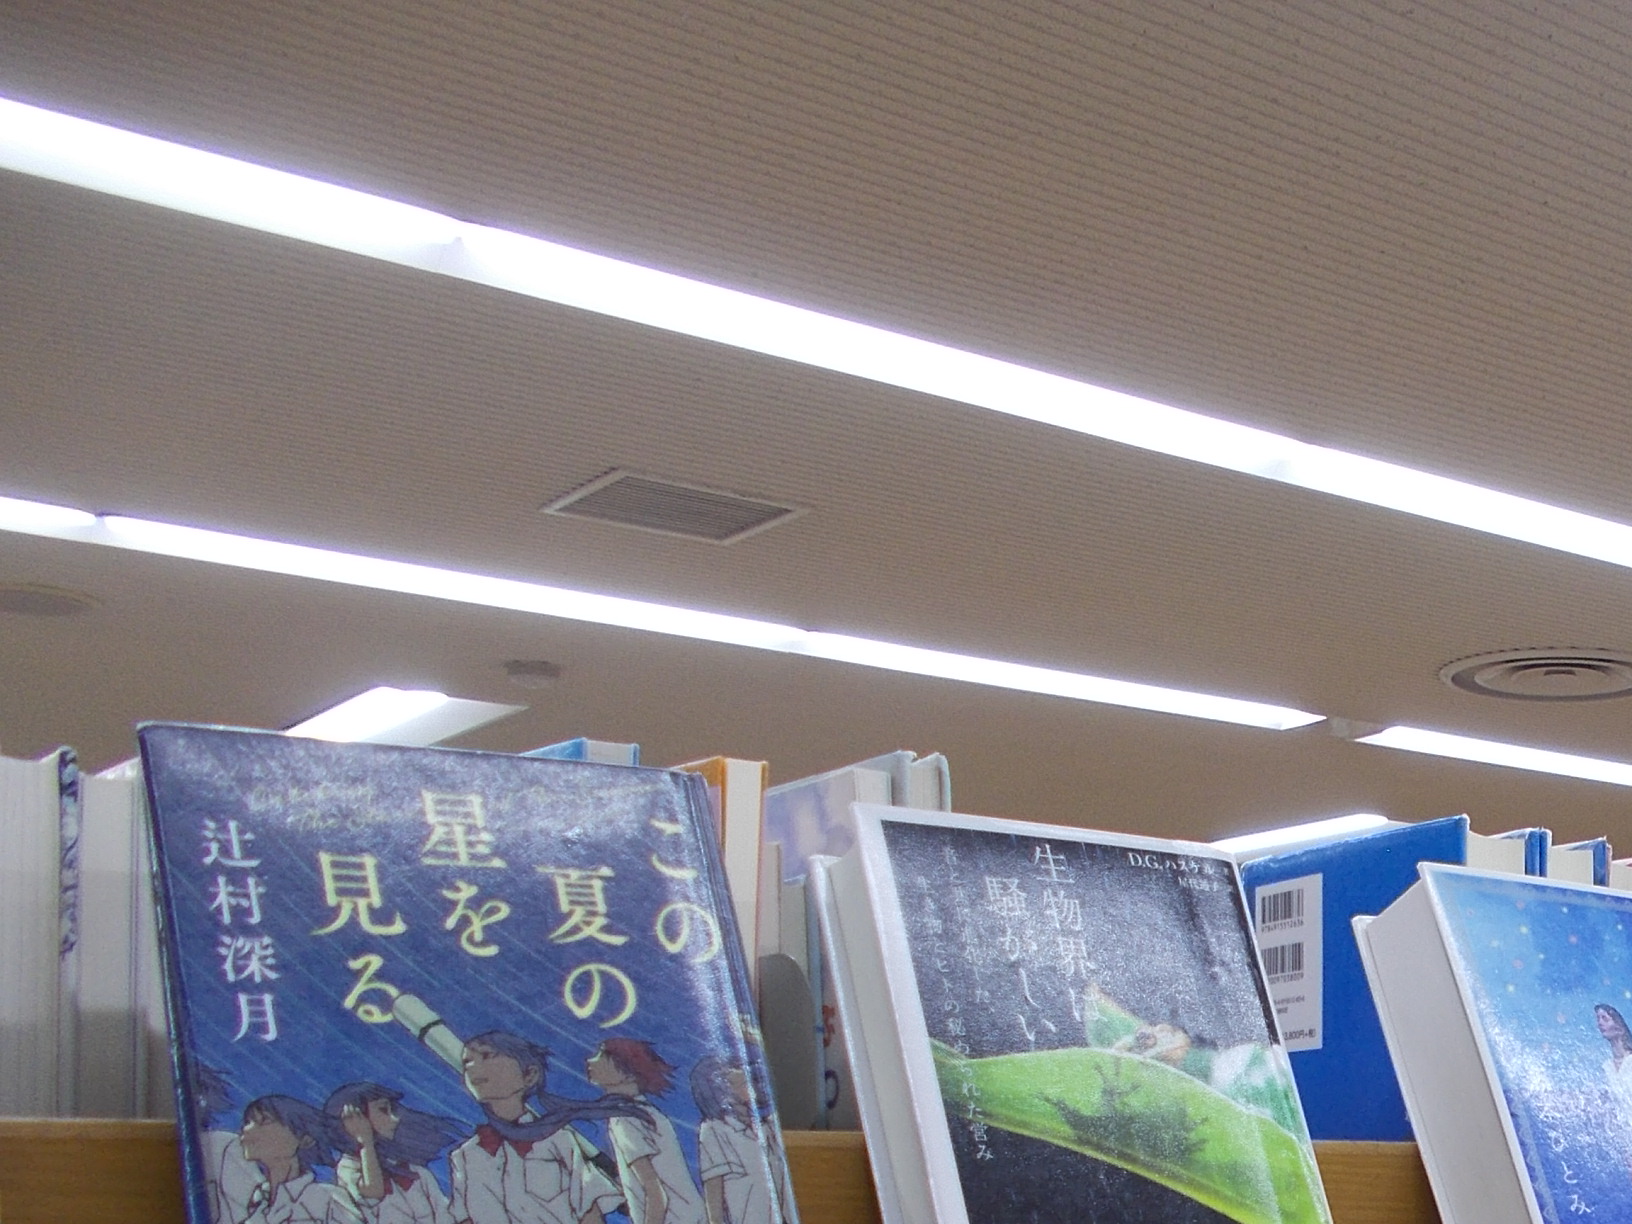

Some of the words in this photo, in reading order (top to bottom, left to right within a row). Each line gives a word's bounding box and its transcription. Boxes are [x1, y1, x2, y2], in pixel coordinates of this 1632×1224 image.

[199, 818, 281, 1044] 辻村深月
[310, 850, 406, 1025] 見る
[420, 788, 510, 958] 星を
[534, 865, 638, 1029] 夏の
[651, 818, 722, 964] この
